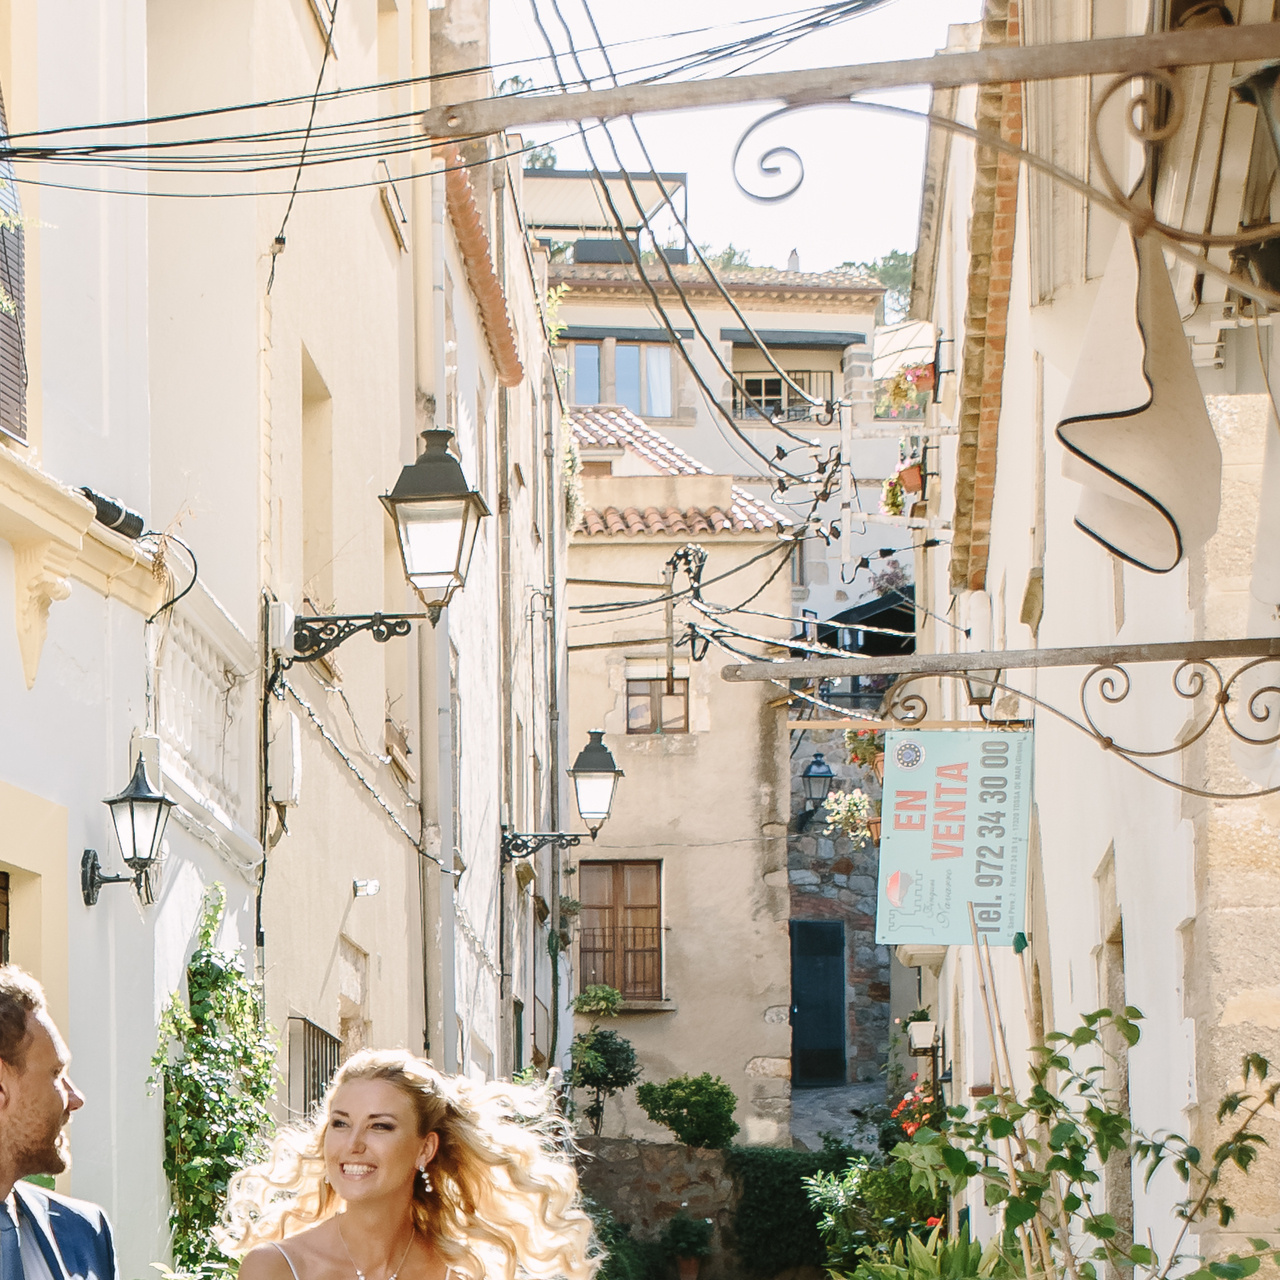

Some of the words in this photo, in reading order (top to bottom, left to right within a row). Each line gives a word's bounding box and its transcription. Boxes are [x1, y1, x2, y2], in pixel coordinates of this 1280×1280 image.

[981, 741, 1009, 768] 00
[979, 776, 1007, 803] 30
[892, 790, 927, 831] EN
[931, 762, 969, 860] VENTA
[977, 811, 1006, 838] 34
[974, 845, 1004, 887] 972
[935, 868, 952, 928] Navarro
[972, 895, 1002, 933] Tel.
